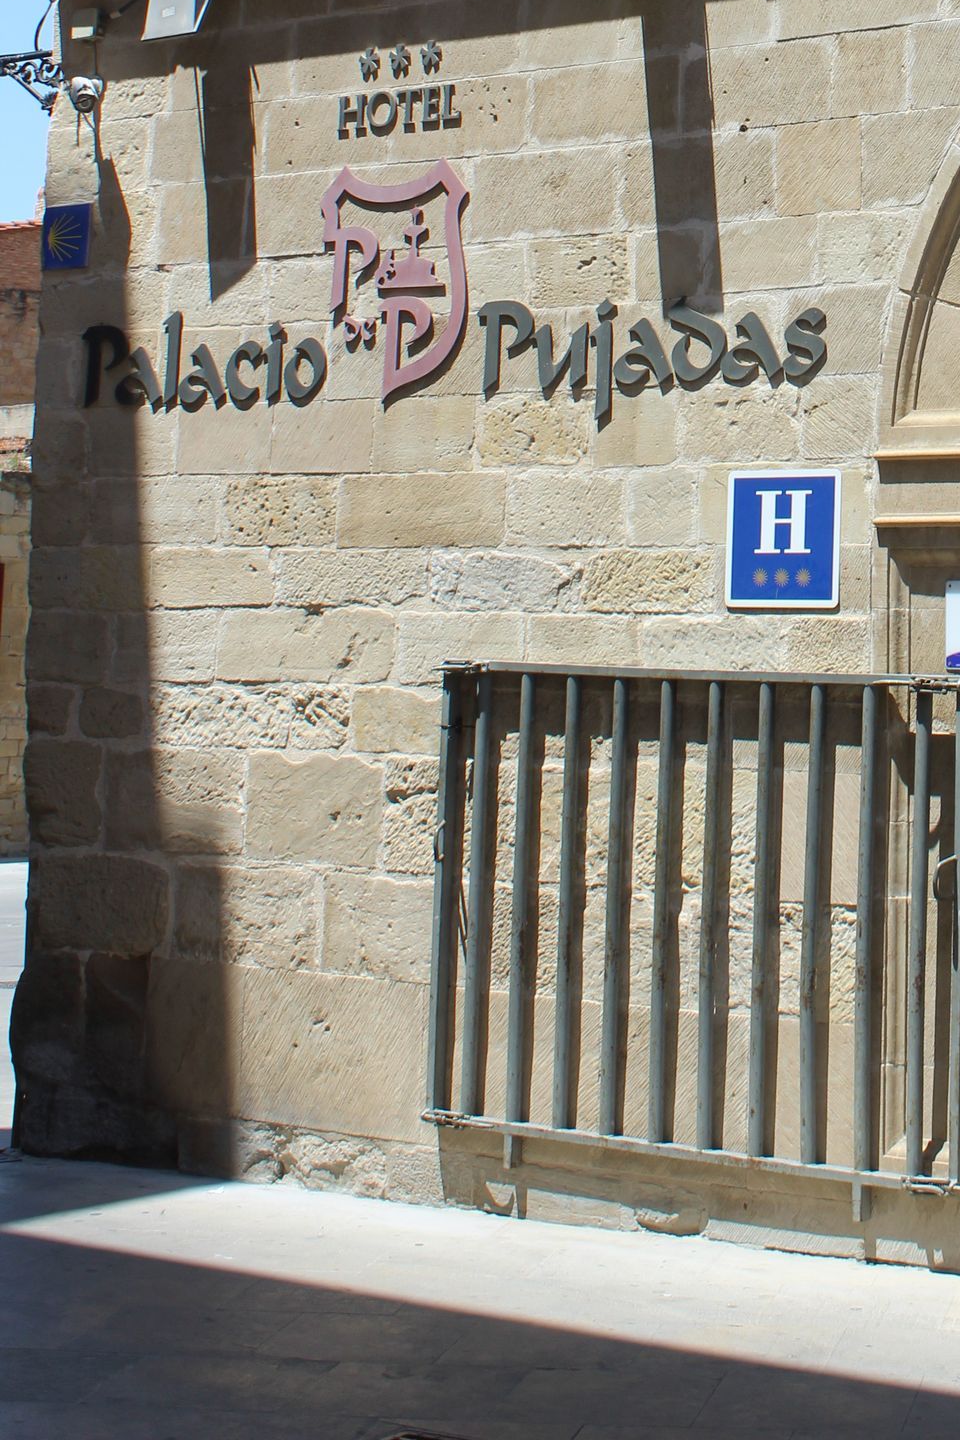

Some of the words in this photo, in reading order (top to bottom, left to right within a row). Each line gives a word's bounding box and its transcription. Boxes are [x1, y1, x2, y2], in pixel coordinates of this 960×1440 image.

[337, 84, 462, 139] HOTEL
[82, 311, 327, 413] Palacio
[478, 298, 828, 433] Pujadas
[754, 490, 812, 554] H
